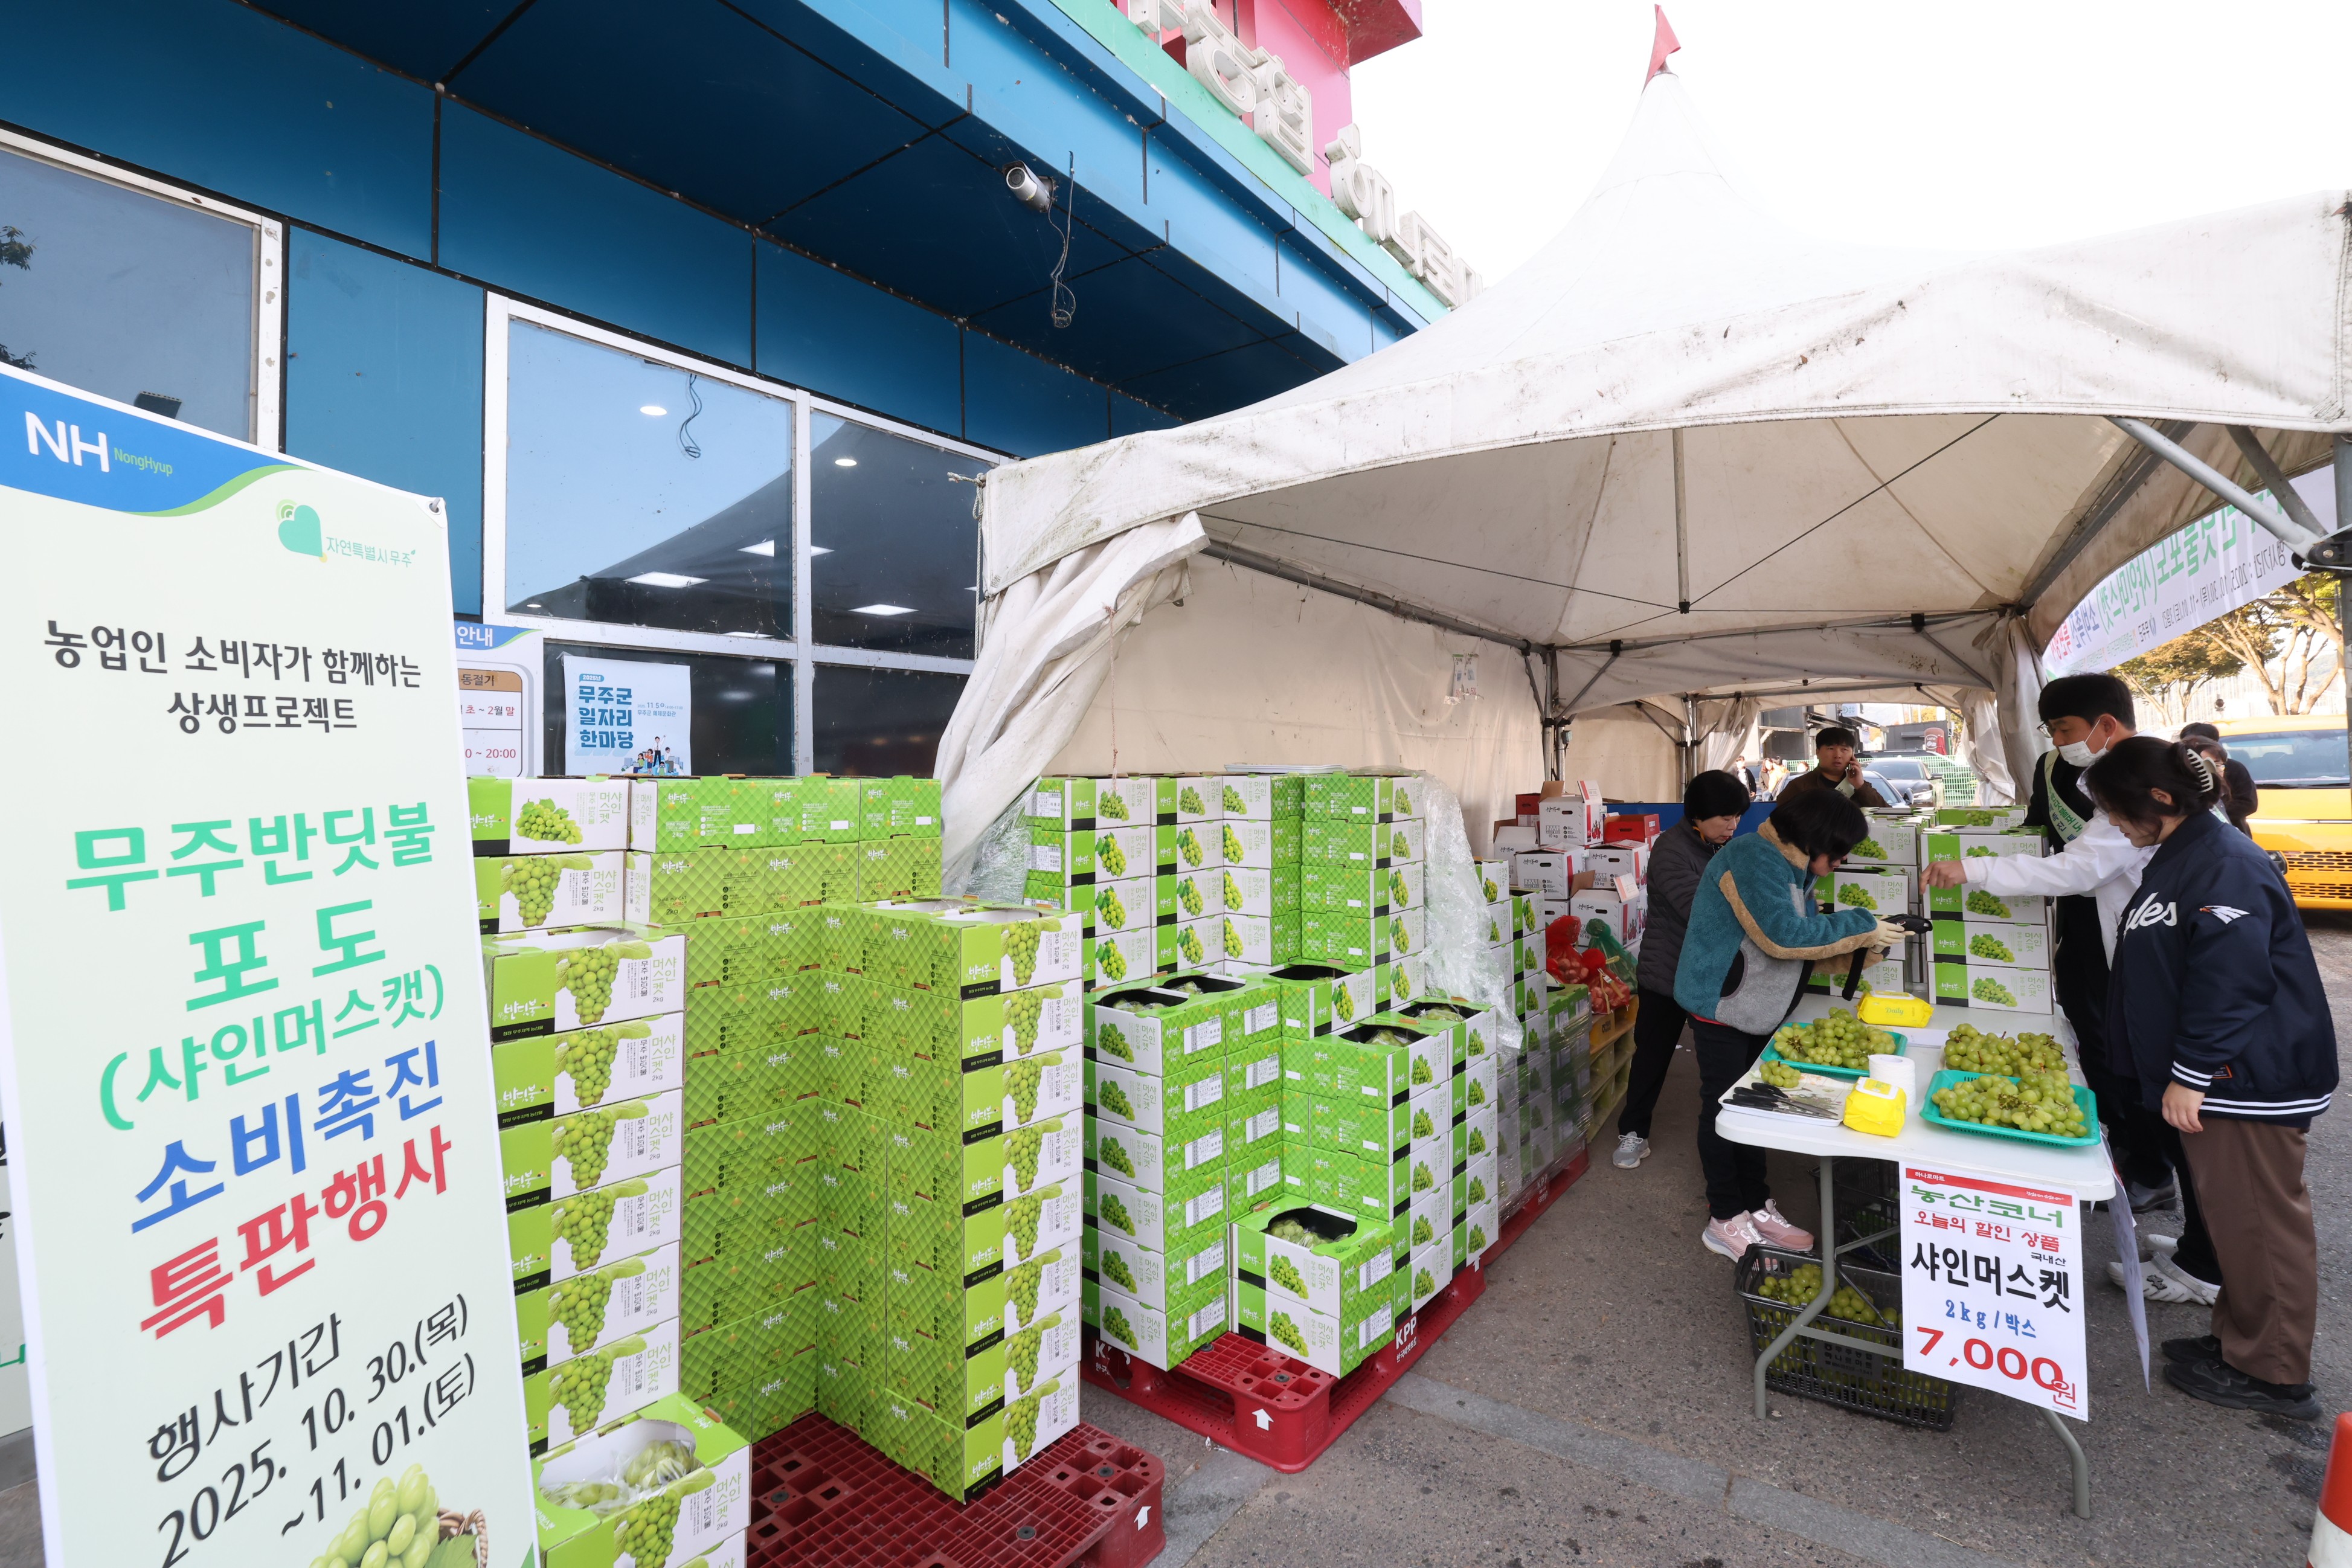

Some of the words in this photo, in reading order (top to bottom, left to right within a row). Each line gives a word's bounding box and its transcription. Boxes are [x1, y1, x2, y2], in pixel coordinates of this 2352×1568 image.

[25, 411, 110, 472] NH
[114, 448, 173, 477] NongHyup
[457, 626, 493, 647] 안내
[45, 621, 168, 673] 농업인
[185, 637, 312, 682] 소비자가
[322, 649, 422, 688] 함께하는
[461, 674, 495, 687] 동절기
[579, 686, 632, 705] 무주군
[168, 693, 357, 734] 상생프로젝트
[488, 705, 503, 716] 2월
[506, 706, 515, 716] 말
[579, 707, 632, 727] 일자리
[486, 748, 516, 759] 20:00
[579, 730, 633, 749] 한마당
[66, 802, 435, 912] 무주반딧불
[593, 870, 604, 905] 머스켓
[605, 870, 617, 893] 샤인
[652, 959, 664, 995] 머스켓
[664, 956, 676, 982] 샤인
[1885, 1007, 1904, 1015] Daily
[100, 964, 444, 1131] (샤인머스캣)
[652, 1035, 663, 1074] 머스켓
[664, 1033, 676, 1059] 샤인
[132, 1039, 443, 1234] 소비촉진
[649, 1115, 661, 1152] 머스켓
[661, 1111, 673, 1138] 샤인
[1915, 1171, 1946, 1182] 하나로마트
[649, 1191, 660, 1229] 머스켓
[661, 1187, 673, 1213] 샤인
[1911, 1185, 2063, 1228] 농산코너
[140, 1125, 451, 1340] 특판행사
[1914, 1210, 1965, 1233] 오늘의
[1975, 1221, 2011, 1242] 할인
[2021, 1232, 2060, 1252] 상품
[2031, 1252, 2066, 1267] 국내산
[646, 1268, 658, 1308] 머스켓
[659, 1265, 670, 1292] 샤인
[1910, 1242, 2071, 1313] 샤인머스켓
[1396, 1316, 1416, 1350] KPP
[647, 1346, 659, 1387] 머스켓
[660, 1341, 672, 1369] 샤인
[147, 1313, 341, 1482] 행사기간
[158, 1440, 287, 1568] 2025.
[301, 1389, 355, 1451] 10.
[729, 1472, 742, 1502] 샤인
[716, 1479, 728, 1522] 머스켓
[716, 1521, 728, 1531] 2kg
